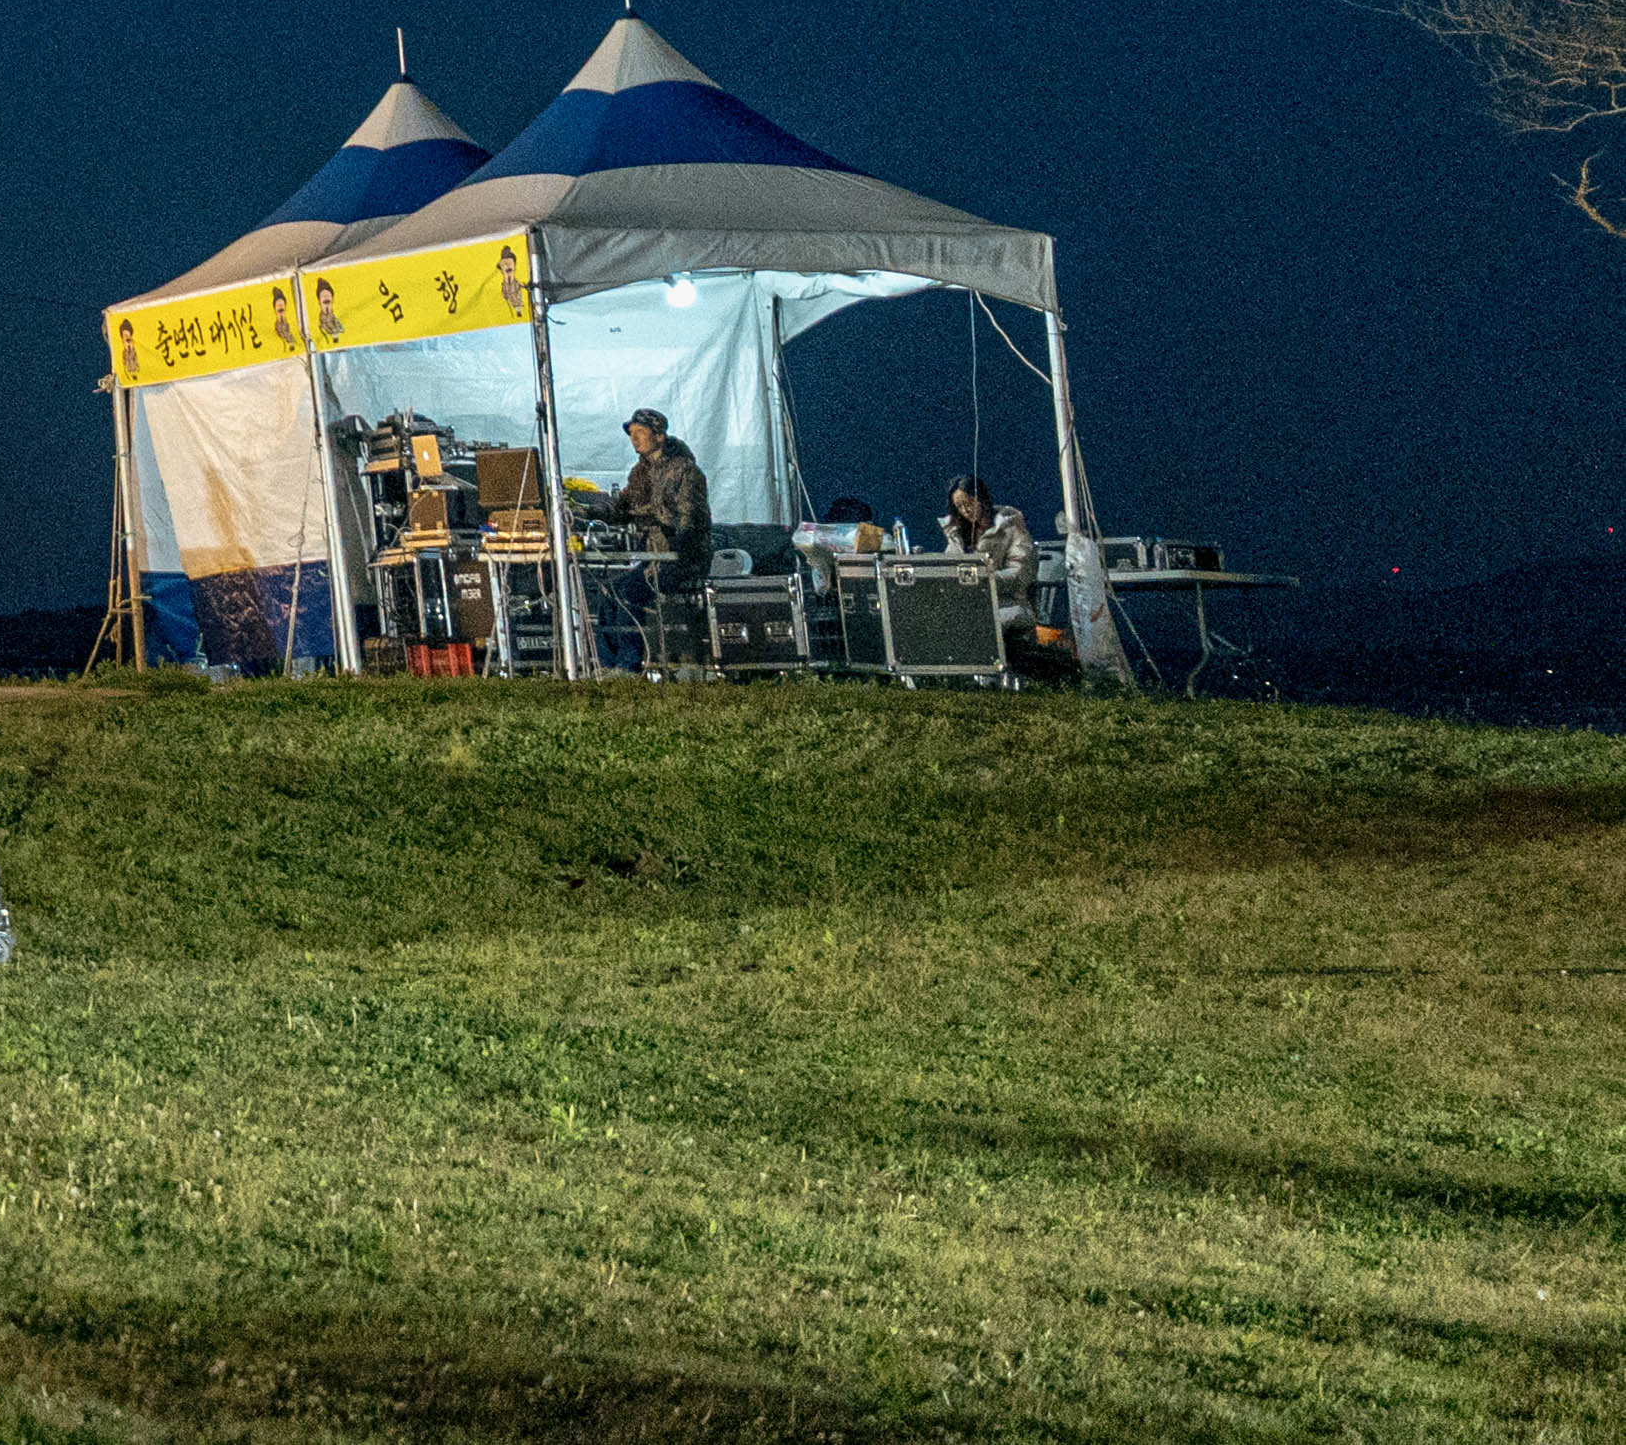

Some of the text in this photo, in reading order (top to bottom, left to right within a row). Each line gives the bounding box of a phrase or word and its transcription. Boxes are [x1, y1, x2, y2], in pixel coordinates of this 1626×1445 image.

[378, 270, 459, 323] 음 향
[155, 303, 262, 367] 출연진 대기실
